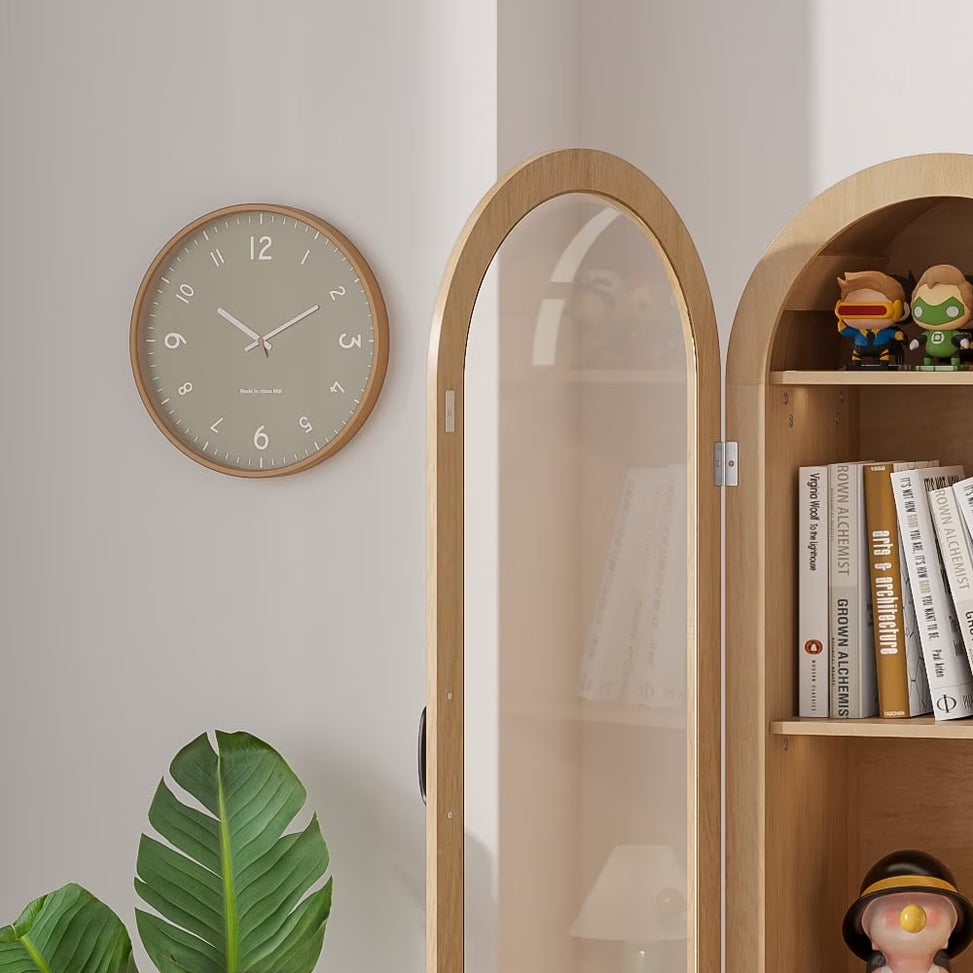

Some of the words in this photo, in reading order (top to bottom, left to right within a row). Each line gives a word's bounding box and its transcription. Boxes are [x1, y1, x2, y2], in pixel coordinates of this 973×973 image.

[250, 236, 272, 260] 12
[301, 250, 310, 265] 1
[176, 284, 194, 304] 10
[329, 286, 346, 301] 2
[164, 333, 186, 348] 9
[339, 333, 361, 349] 3
[178, 382, 193, 395] 8
[330, 381, 346, 394] 4
[210, 417, 224, 433] 7
[299, 416, 313, 433] 5
[253, 425, 269, 450] 6
[807, 473, 820, 500] Virginia
[809, 500, 820, 520] Woolf
[837, 507, 850, 576] ALCHEMIST
[872, 530, 893, 556] arts
[904, 501, 916, 513] HOW
[917, 566, 928, 578] HOW
[875, 562, 892, 571] &
[944, 528, 970, 589] ALCHEMIST
[837, 598, 849, 647] GROWN
[875, 576, 899, 655] architecture
[838, 651, 850, 718] ALCHEMIS
